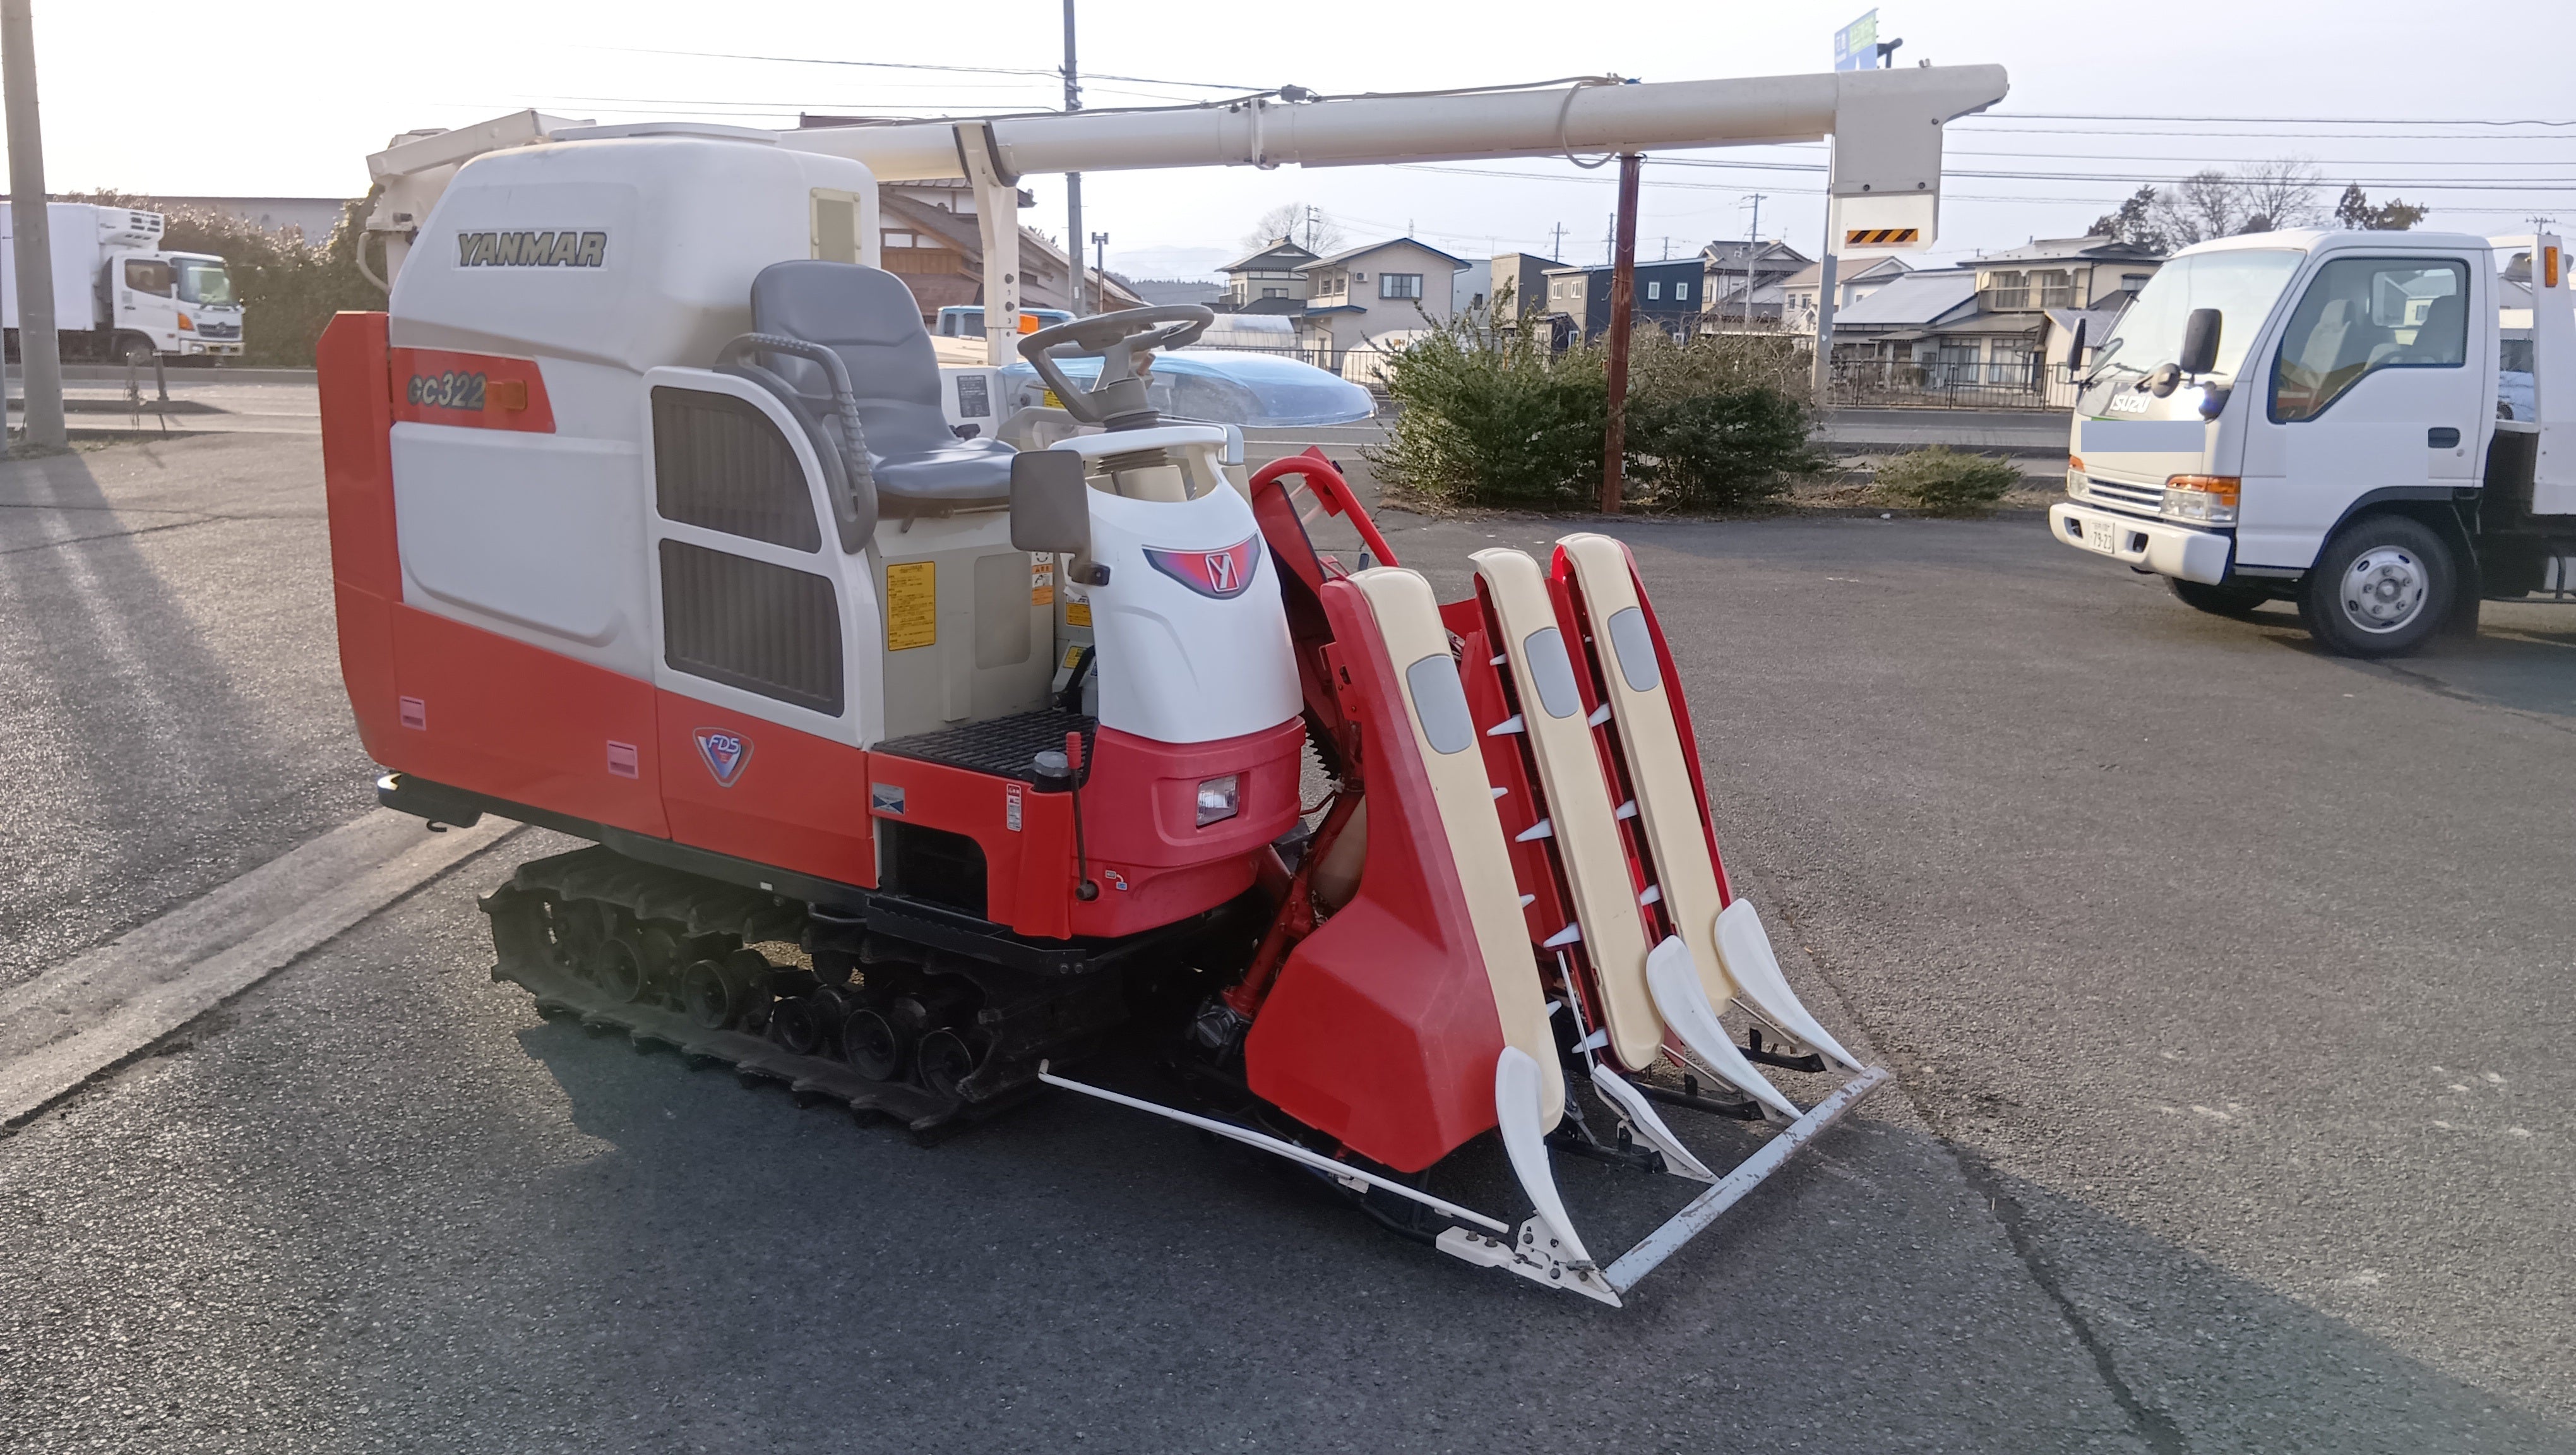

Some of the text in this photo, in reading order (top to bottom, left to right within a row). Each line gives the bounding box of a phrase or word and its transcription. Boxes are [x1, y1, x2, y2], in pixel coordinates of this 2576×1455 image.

[458, 232, 607, 266] YANMAR
[407, 370, 487, 411] GC322
[2109, 394, 2151, 413] ISUZU
[708, 734, 740, 753] FDS
